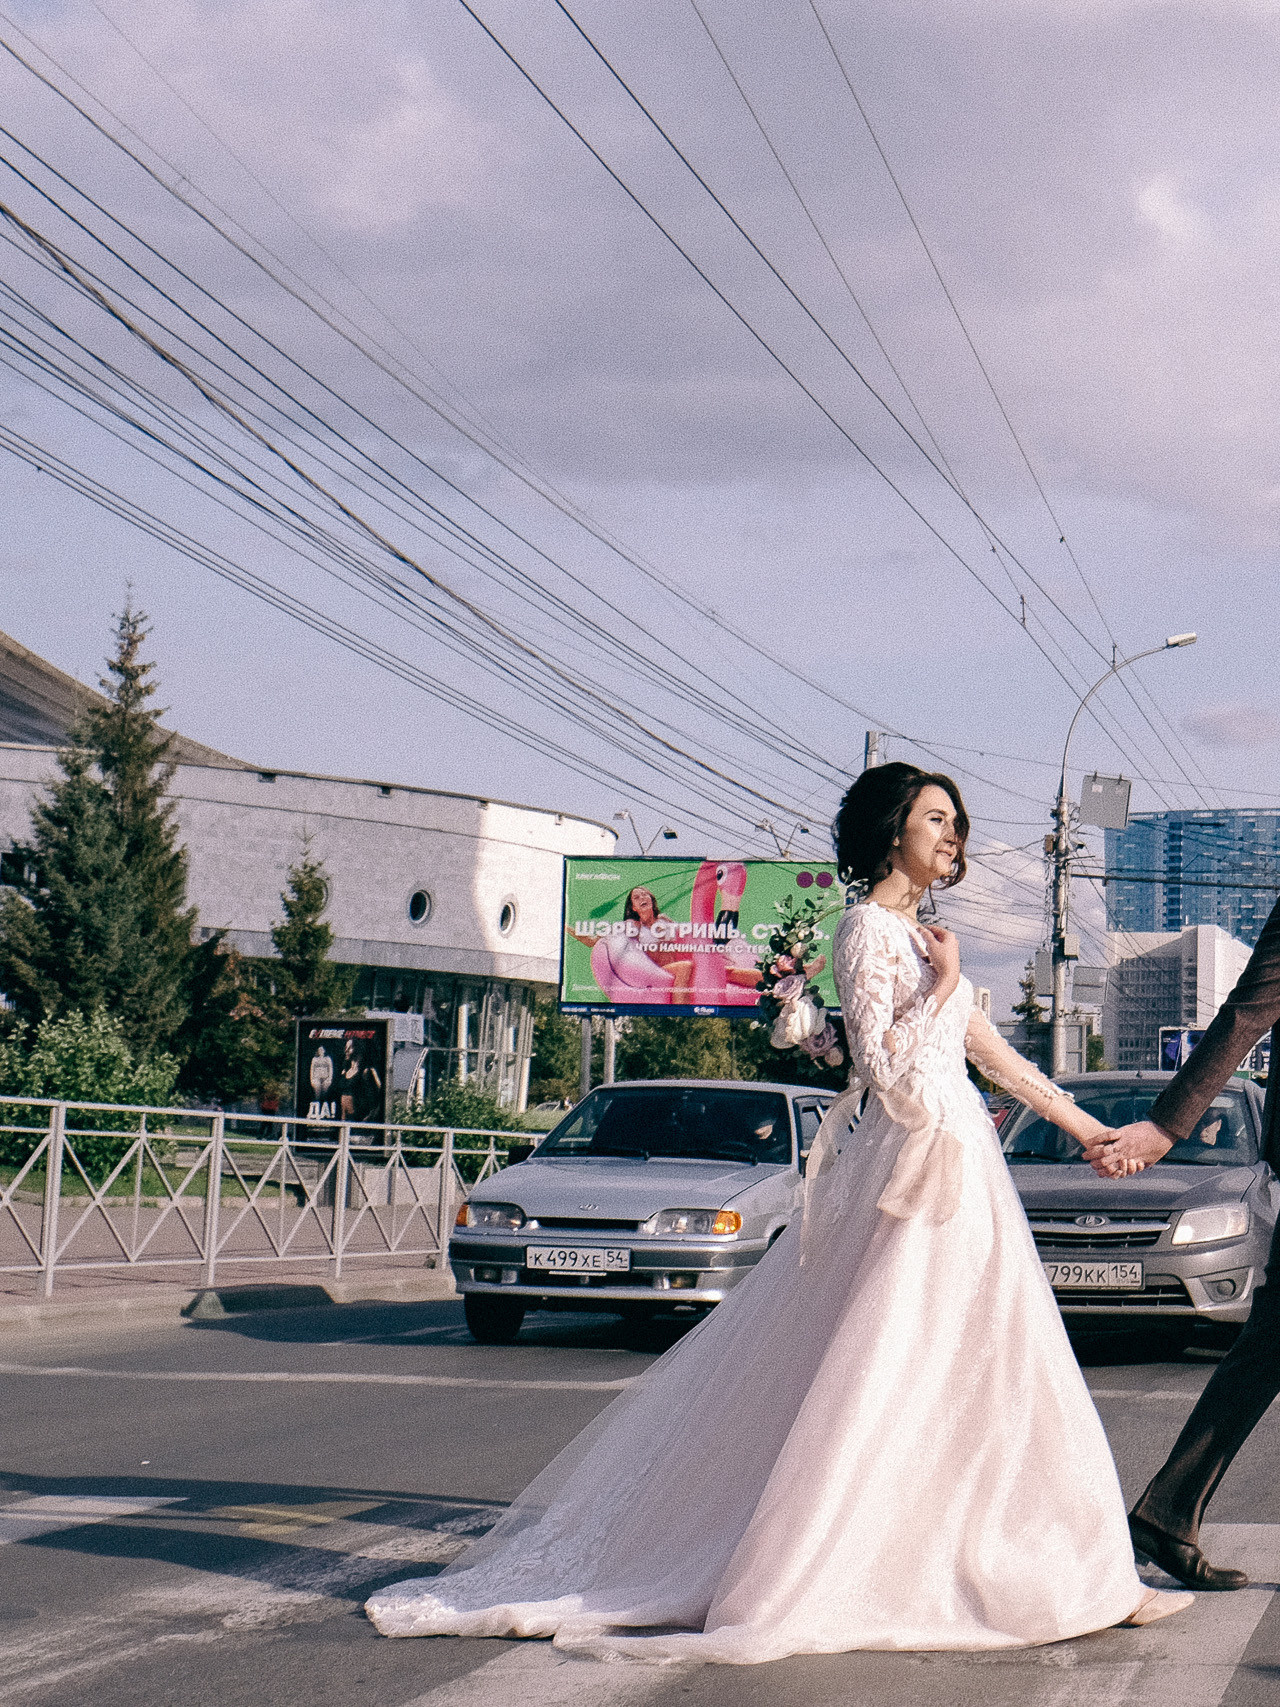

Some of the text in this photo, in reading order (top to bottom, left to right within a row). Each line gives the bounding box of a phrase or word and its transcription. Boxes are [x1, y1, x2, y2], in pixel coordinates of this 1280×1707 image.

[650, 922, 747, 940] СТРИМЬ.
[752, 923, 831, 941] СТЬ.
[635, 942, 658, 953] ЧТО
[660, 943, 732, 954] НАЧИНАЕТСЯ
[734, 944, 744, 954] С
[306, 1101, 337, 1120] ДА!
[606, 1251, 624, 1264] 54
[1043, 1264, 1138, 1283] 799КК 154
